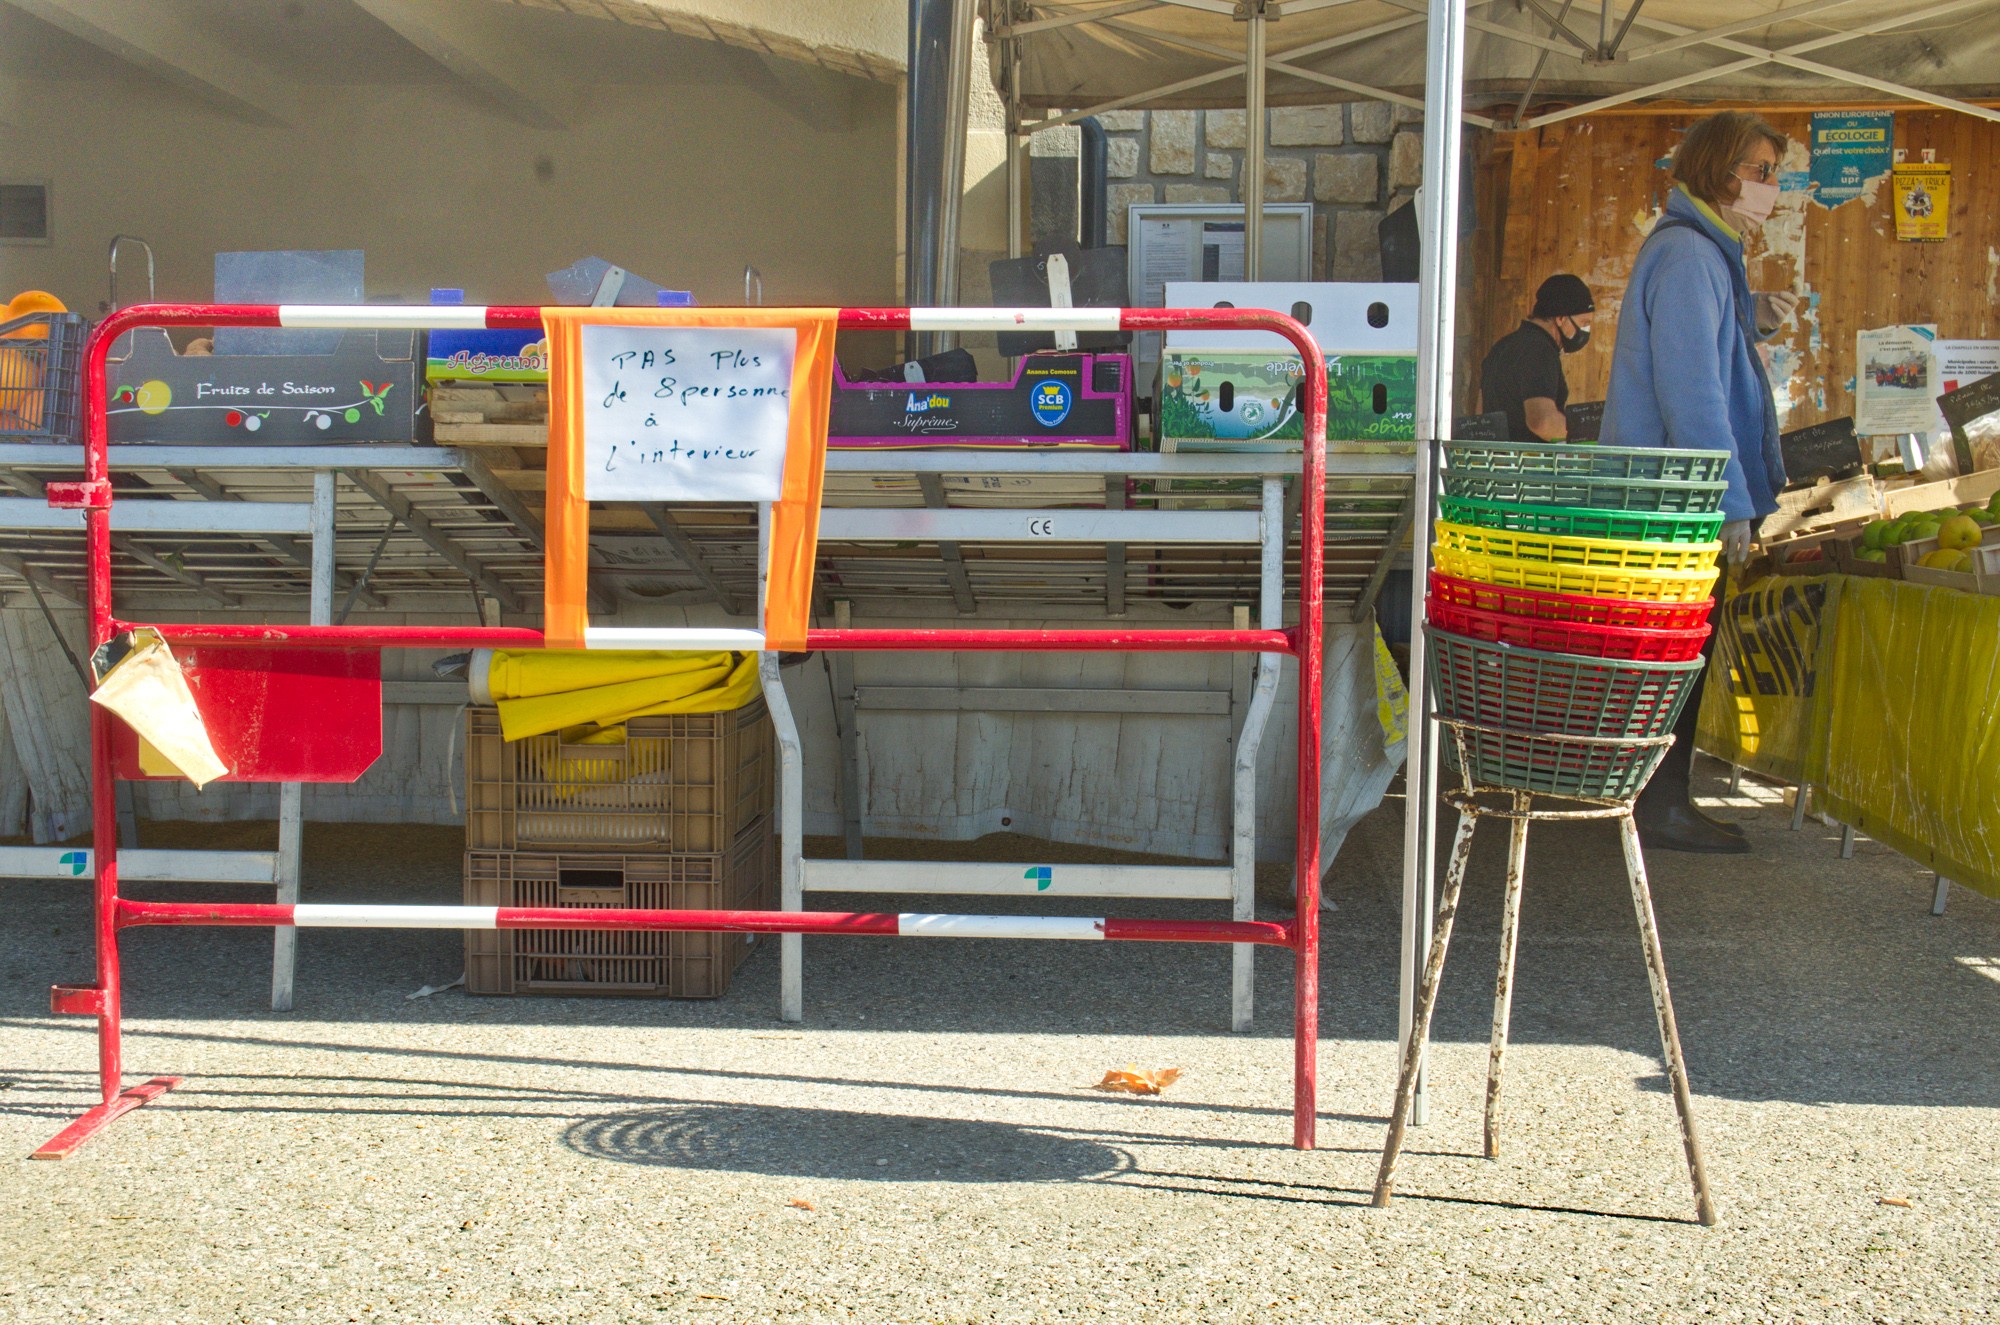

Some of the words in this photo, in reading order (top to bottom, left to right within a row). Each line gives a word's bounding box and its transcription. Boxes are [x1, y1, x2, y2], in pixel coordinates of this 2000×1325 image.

[1814, 111, 1840, 119] UNION
[1813, 147, 1830, 156] Quel
[1865, 146, 1883, 154] choix
[1841, 176, 1860, 185] upr
[611, 349, 676, 370] PAS
[710, 349, 762, 370] Plus
[1266, 362, 1304, 376] Verde
[1325, 362, 1342, 376] Lu
[197, 382, 250, 398] Fruits
[257, 381, 275, 395] de
[282, 381, 336, 395] Saison
[603, 380, 627, 408] de
[654, 377, 677, 398] 8
[906, 392, 950, 413] Ana'dou
[1037, 394, 1064, 405] SCB
[644, 413, 658, 427] à
[1392, 411, 1413, 422] air
[897, 414, 957, 434] Suprême
[1363, 418, 1416, 434] ango
[1030, 520, 1051, 535] CE
